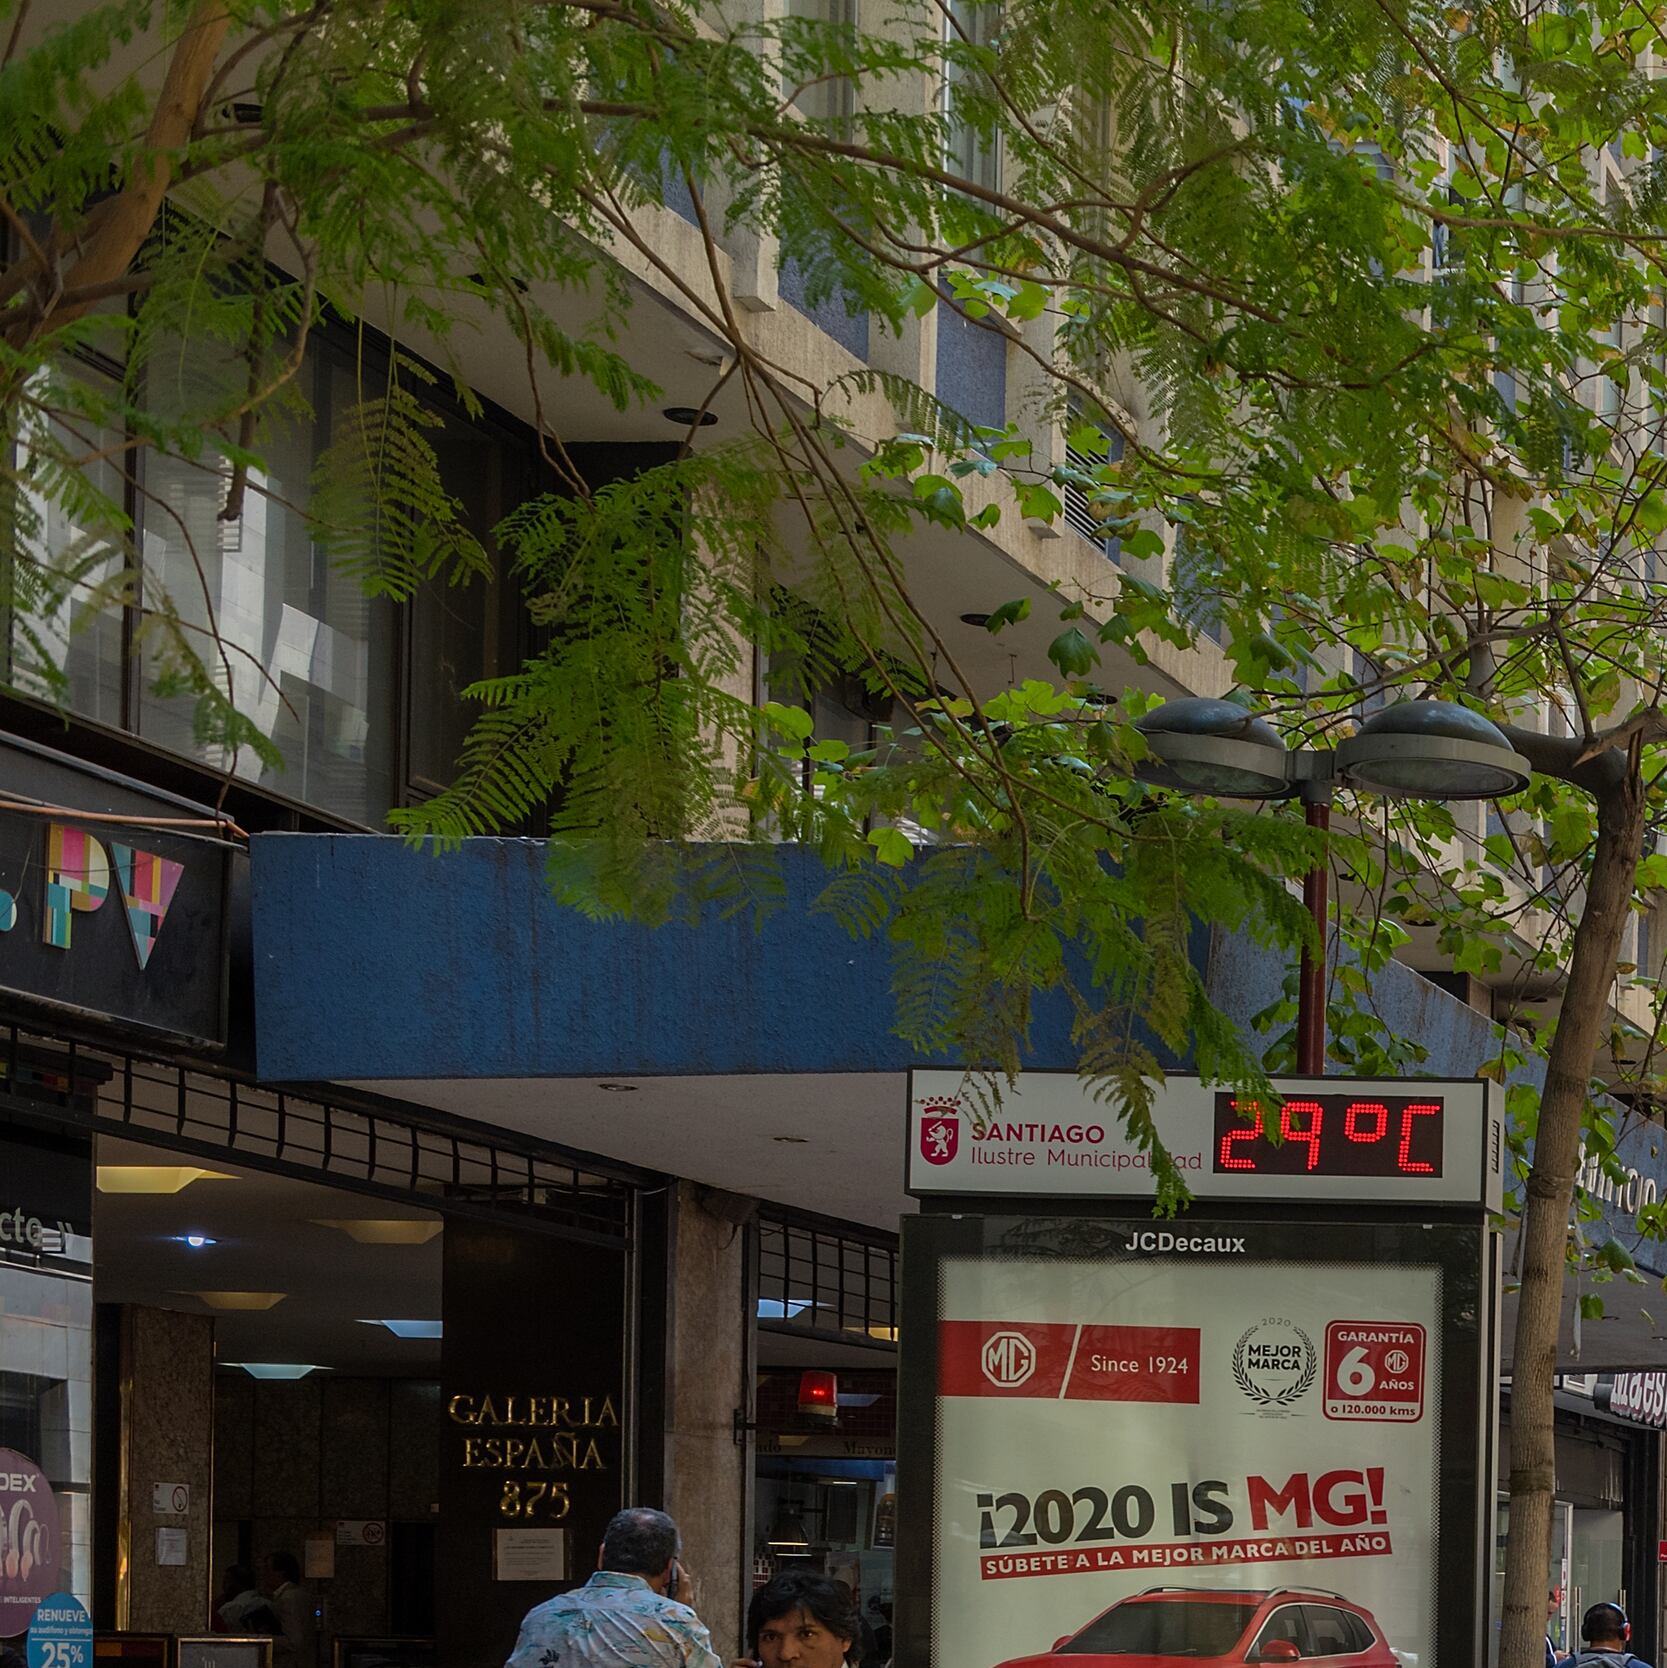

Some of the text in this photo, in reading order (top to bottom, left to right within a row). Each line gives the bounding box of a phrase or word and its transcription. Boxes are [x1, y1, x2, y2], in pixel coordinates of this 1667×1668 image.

[971, 1123, 1105, 1144] SANTIAGO
[971, 1147, 1035, 1166] Ilustre
[1125, 1231, 1246, 1253] JCDecaux
[1262, 1317, 1292, 1328] 2020
[1337, 1332, 1415, 1344] GARANTÍA
[1248, 1345, 1302, 1358] MEJOR
[1091, 1355, 1189, 1375] Since 1924
[1248, 1358, 1302, 1371] MARCA
[1337, 1345, 1376, 1397] 6
[1380, 1378, 1415, 1390] AÑOS
[449, 1394, 620, 1427] GALERIA
[1342, 1404, 1386, 1415] 120.000
[1390, 1405, 1416, 1416] kms
[462, 1431, 608, 1470] ESPAÑA
[500, 1480, 571, 1519] 875
[1171, 1480, 1234, 1537] IS
[1246, 1467, 1388, 1531] MG!
[985, 1533, 1388, 1576] SÚBETE A LA MEJOR MARCA DEL AÑO
[37, 1608, 85, 1623] RENUEVE
